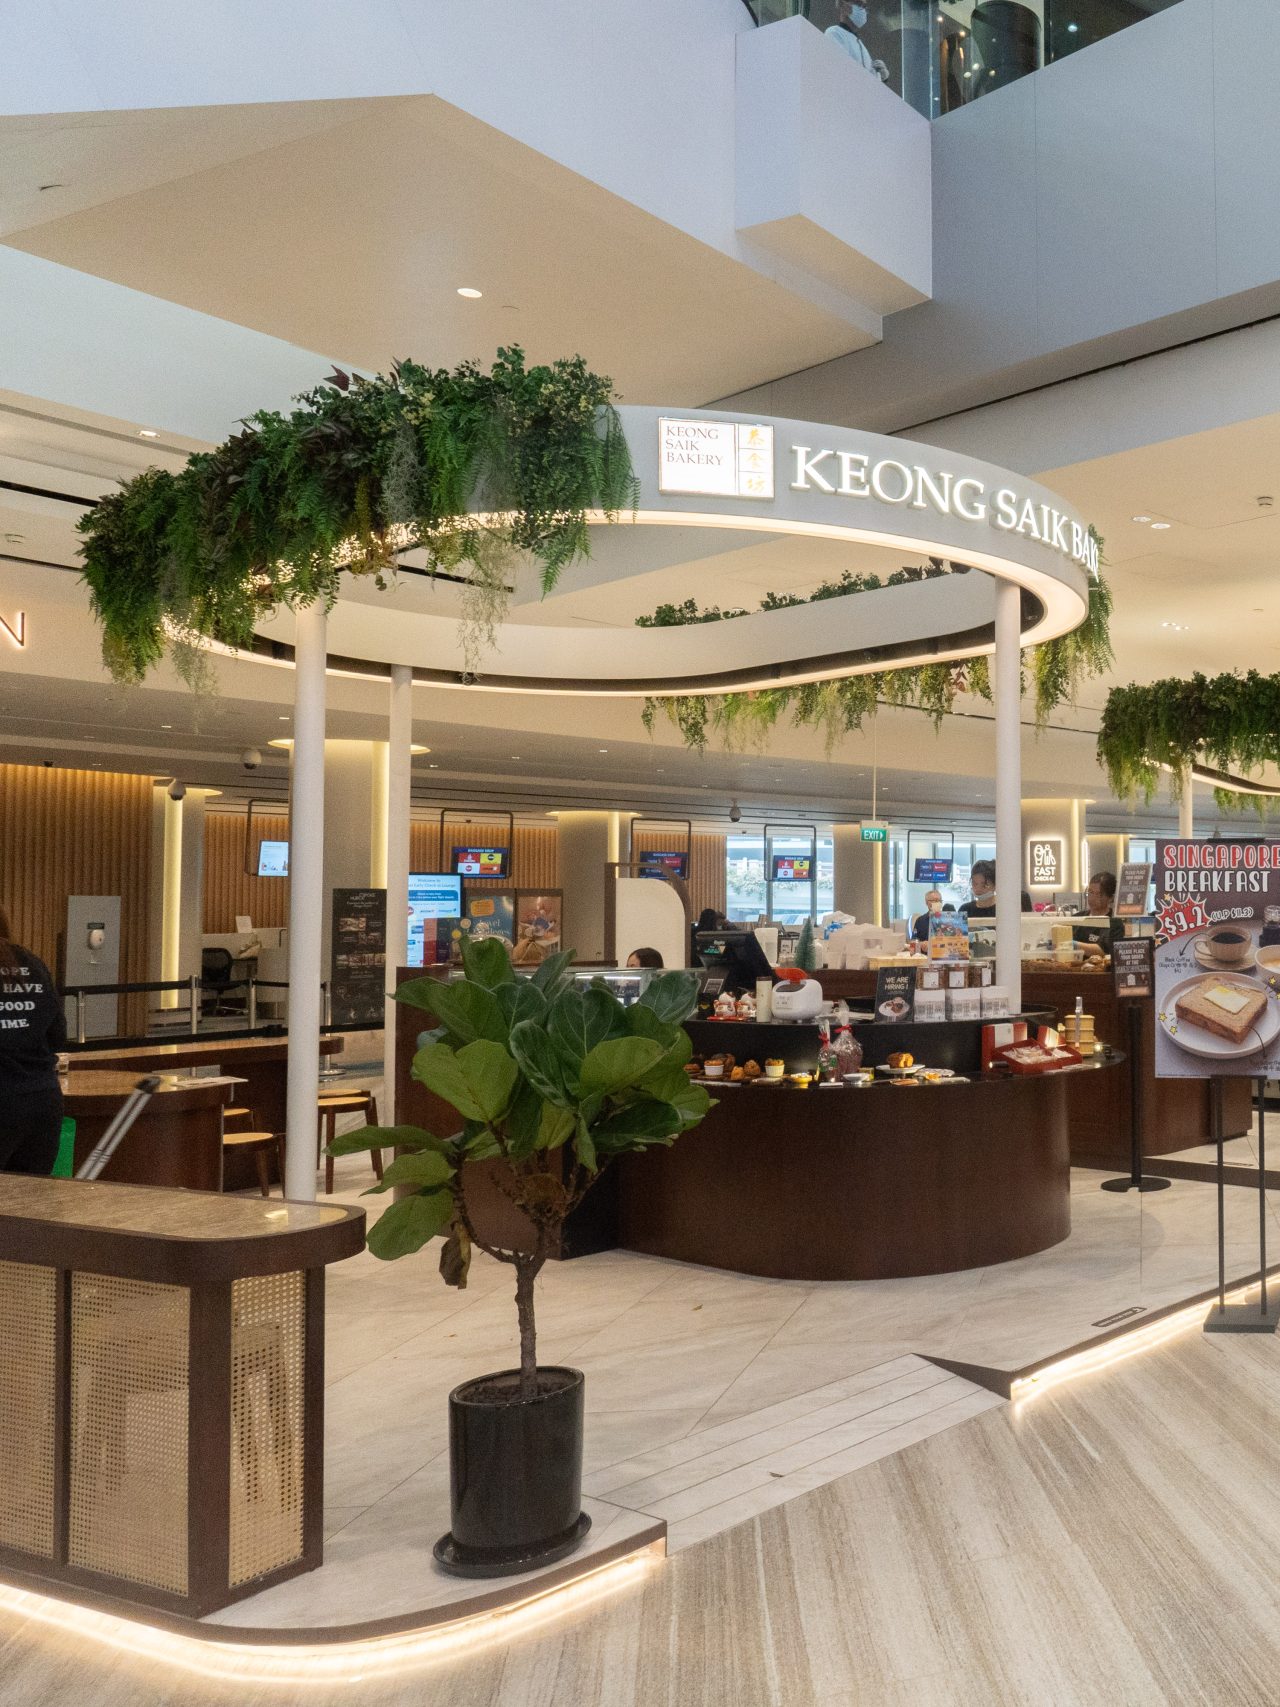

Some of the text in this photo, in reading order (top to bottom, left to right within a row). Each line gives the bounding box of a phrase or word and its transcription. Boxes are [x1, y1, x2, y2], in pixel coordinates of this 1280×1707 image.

[666, 426, 719, 440] KEONG
[665, 439, 700, 451] SAIK
[666, 452, 724, 466] BAKERY
[790, 445, 1100, 584] KEONG SAIK BAK
[863, 831, 879, 840] EXIT
[1034, 866, 1057, 876] FAST
[1164, 870, 1271, 893] BREAKFAST
[1164, 906, 1210, 936] $9.2
[0, 967, 30, 976] OPE
[3, 983, 43, 993] HAVE
[0, 1018, 30, 1029] IME
